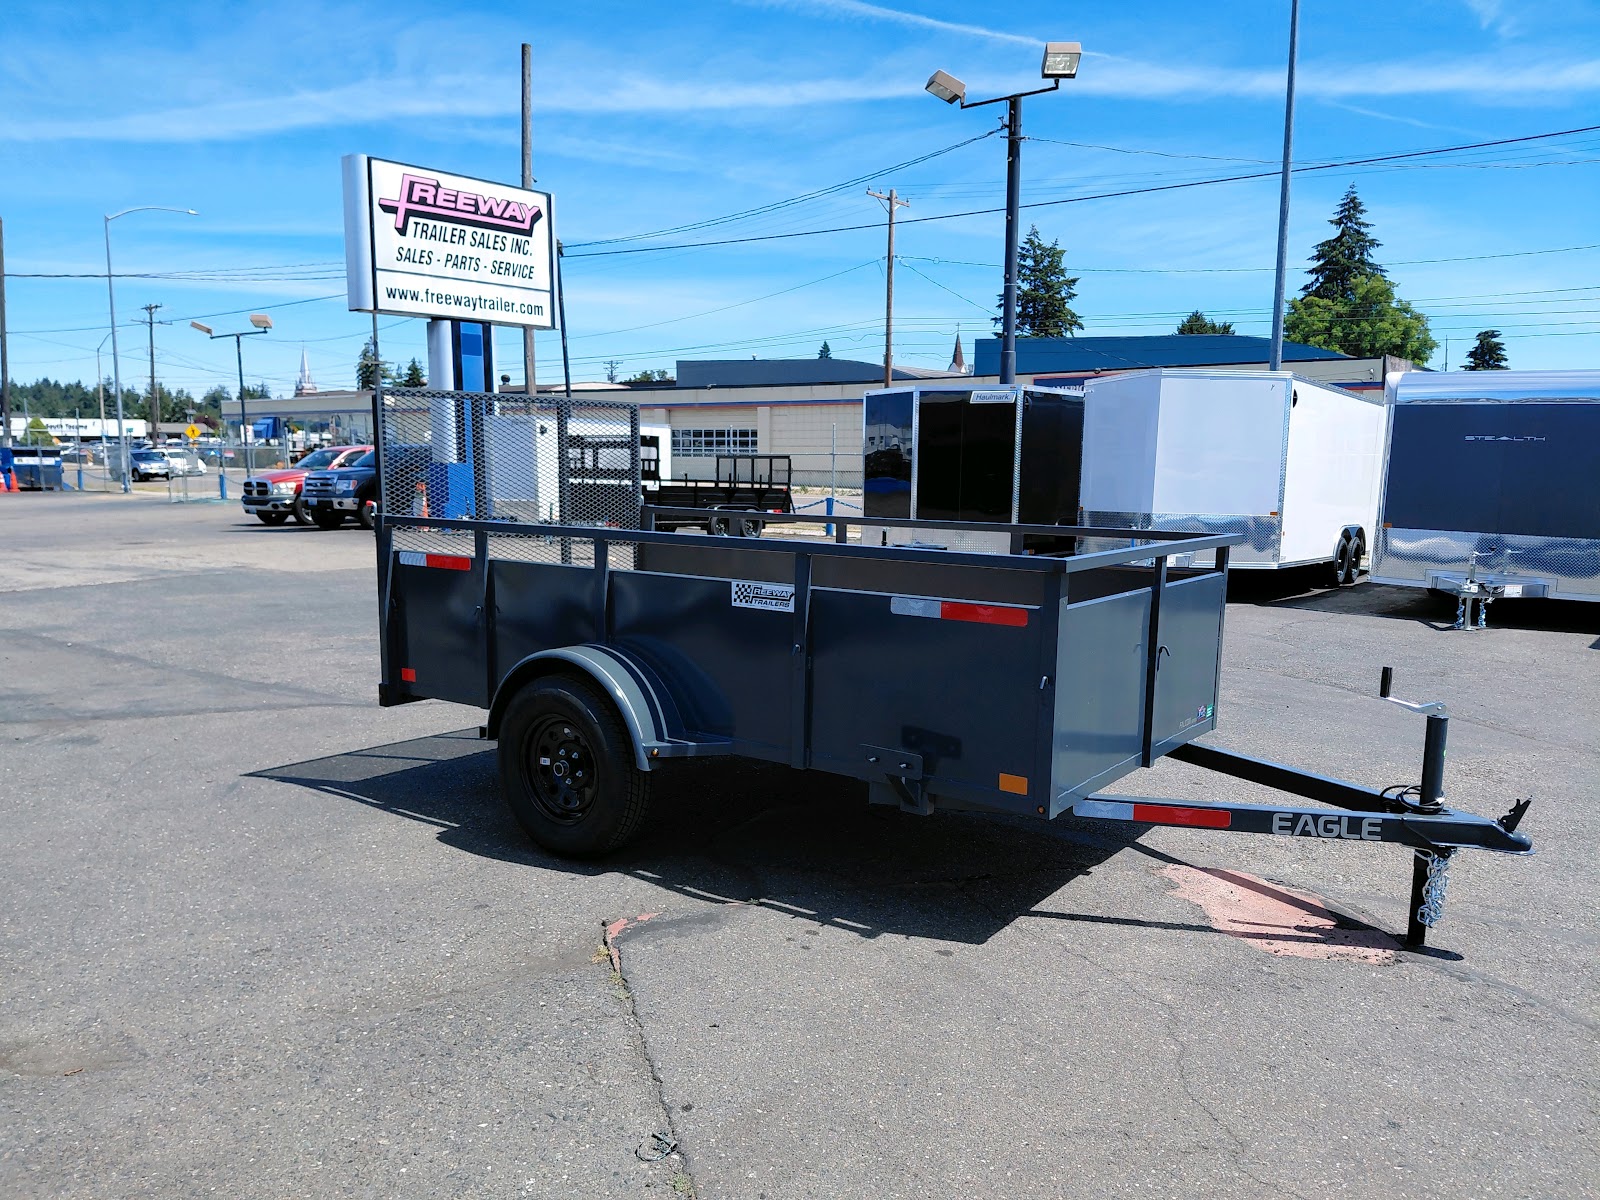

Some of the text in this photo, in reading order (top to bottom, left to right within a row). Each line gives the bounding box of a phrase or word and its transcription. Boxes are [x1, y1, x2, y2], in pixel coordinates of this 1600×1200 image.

[379, 173, 543, 237] FREEWAY
[413, 222, 533, 257] TRAILER SALES INC.
[396, 247, 434, 266] SALES
[444, 254, 481, 273] PARTS
[490, 260, 535, 280] SERVICE
[386, 287, 544, 316] www.freewaytrailer.com
[745, 585, 795, 604] FREEWAY
[752, 599, 791, 608] TRAILERS
[1271, 812, 1383, 841] EAGLE
